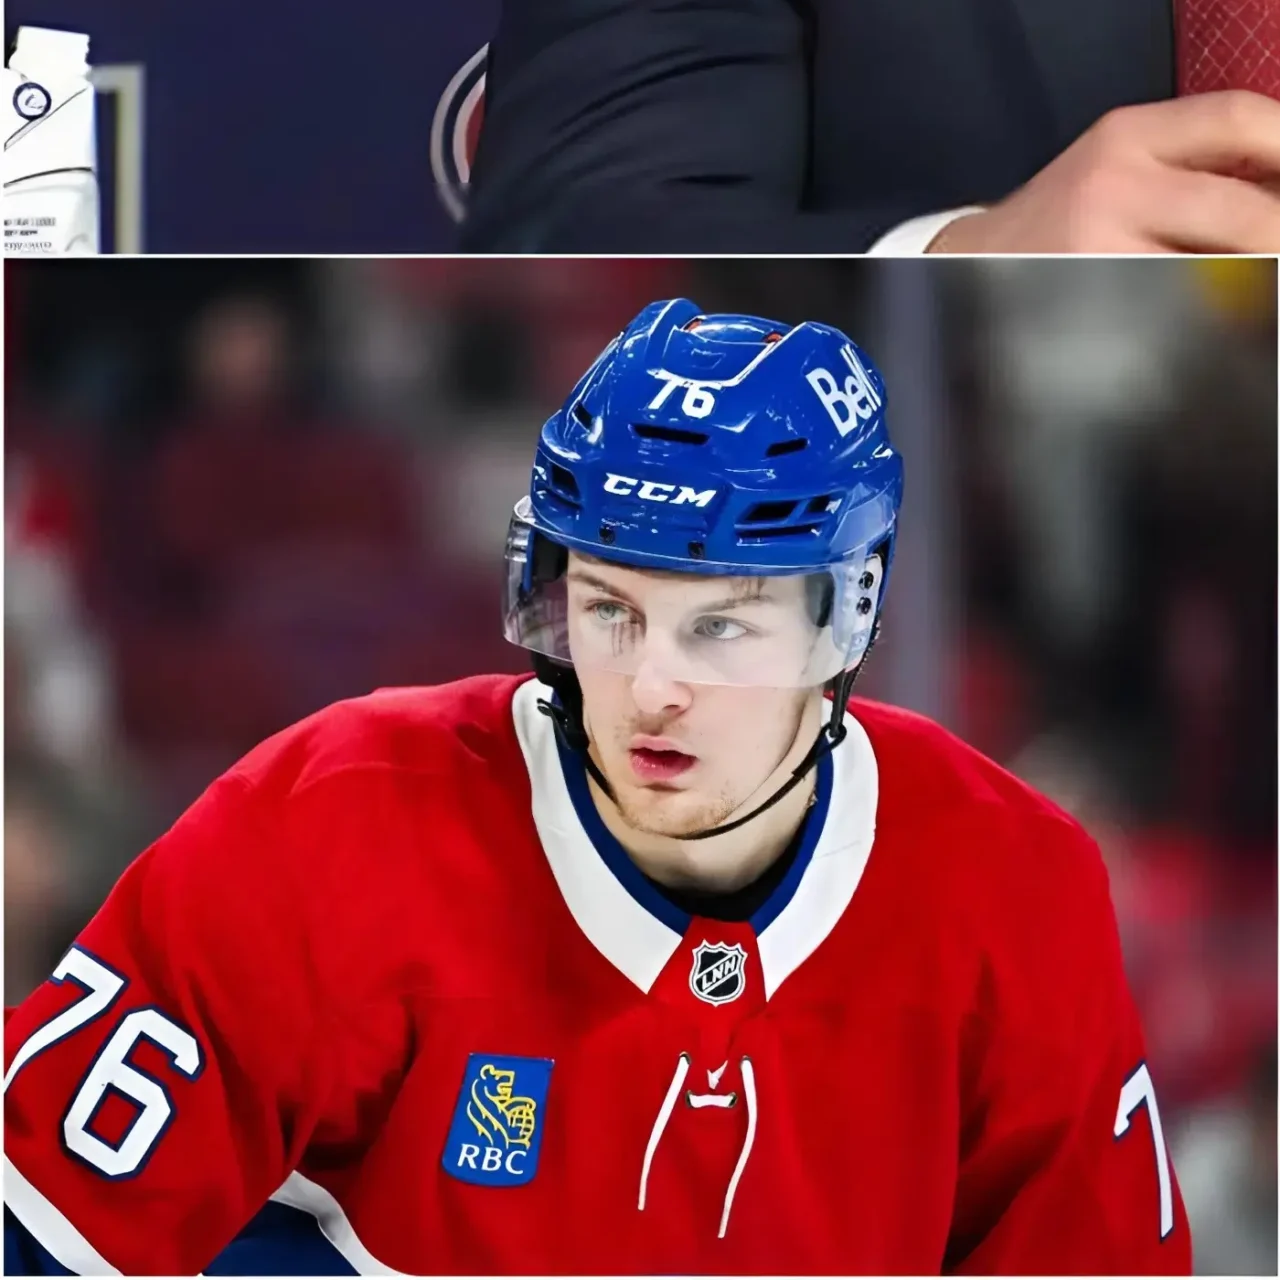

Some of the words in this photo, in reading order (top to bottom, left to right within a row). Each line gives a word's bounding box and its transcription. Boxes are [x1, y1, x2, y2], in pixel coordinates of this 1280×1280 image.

[806, 343, 882, 437] Bell
[603, 472, 717, 508] CCM
[3, 945, 205, 1181] 76
[456, 1143, 528, 1175] RBC
